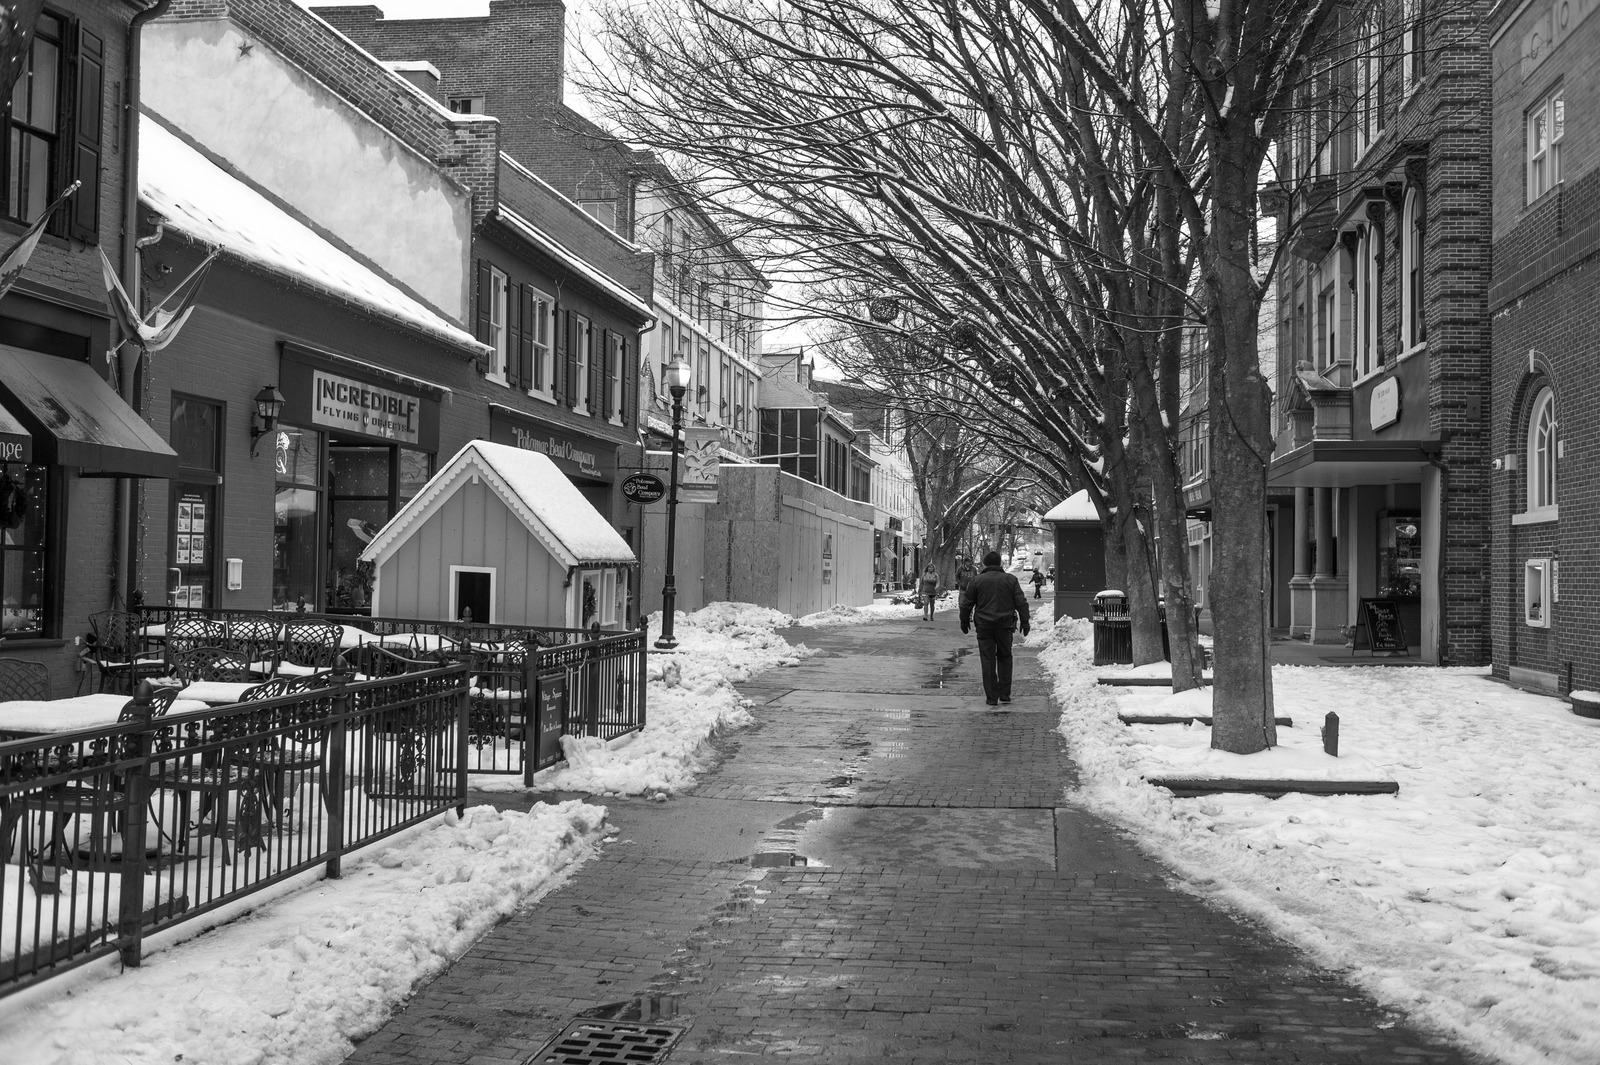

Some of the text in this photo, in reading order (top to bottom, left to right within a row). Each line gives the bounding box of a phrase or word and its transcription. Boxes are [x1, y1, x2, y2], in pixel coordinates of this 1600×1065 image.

[316, 377, 416, 434] INCREDIBLE
[323, 406, 407, 432] FLYING OBJECTS
[517, 428, 549, 455] Potomac
[549, 437, 566, 460] Bead
[565, 441, 596, 468] Company
